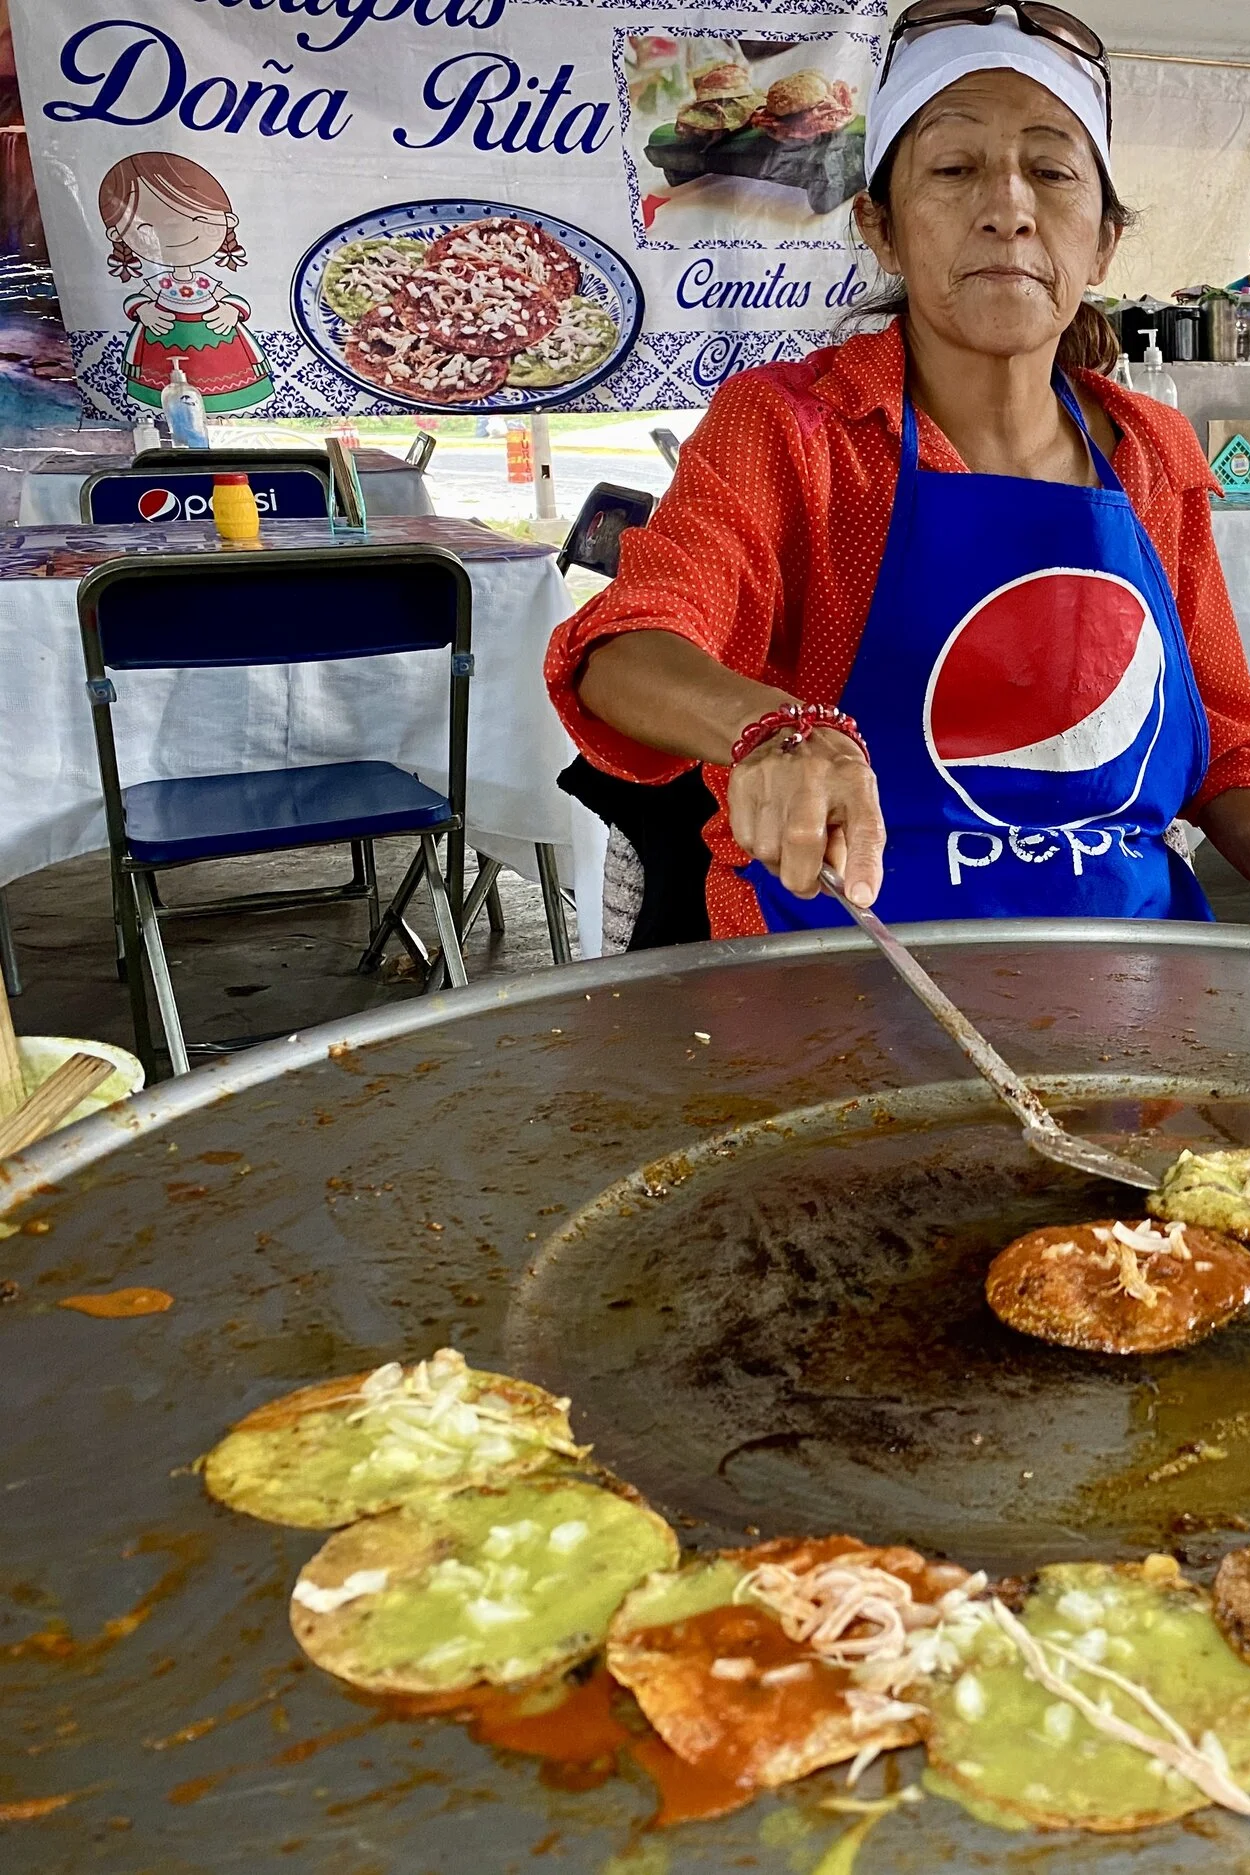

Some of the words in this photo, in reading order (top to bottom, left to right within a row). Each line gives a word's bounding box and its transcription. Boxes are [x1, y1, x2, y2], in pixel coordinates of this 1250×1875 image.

[42, 19, 353, 140] Doña
[392, 51, 615, 154] Rita
[676, 258, 812, 310] Cemitas
[825, 264, 868, 308] de
